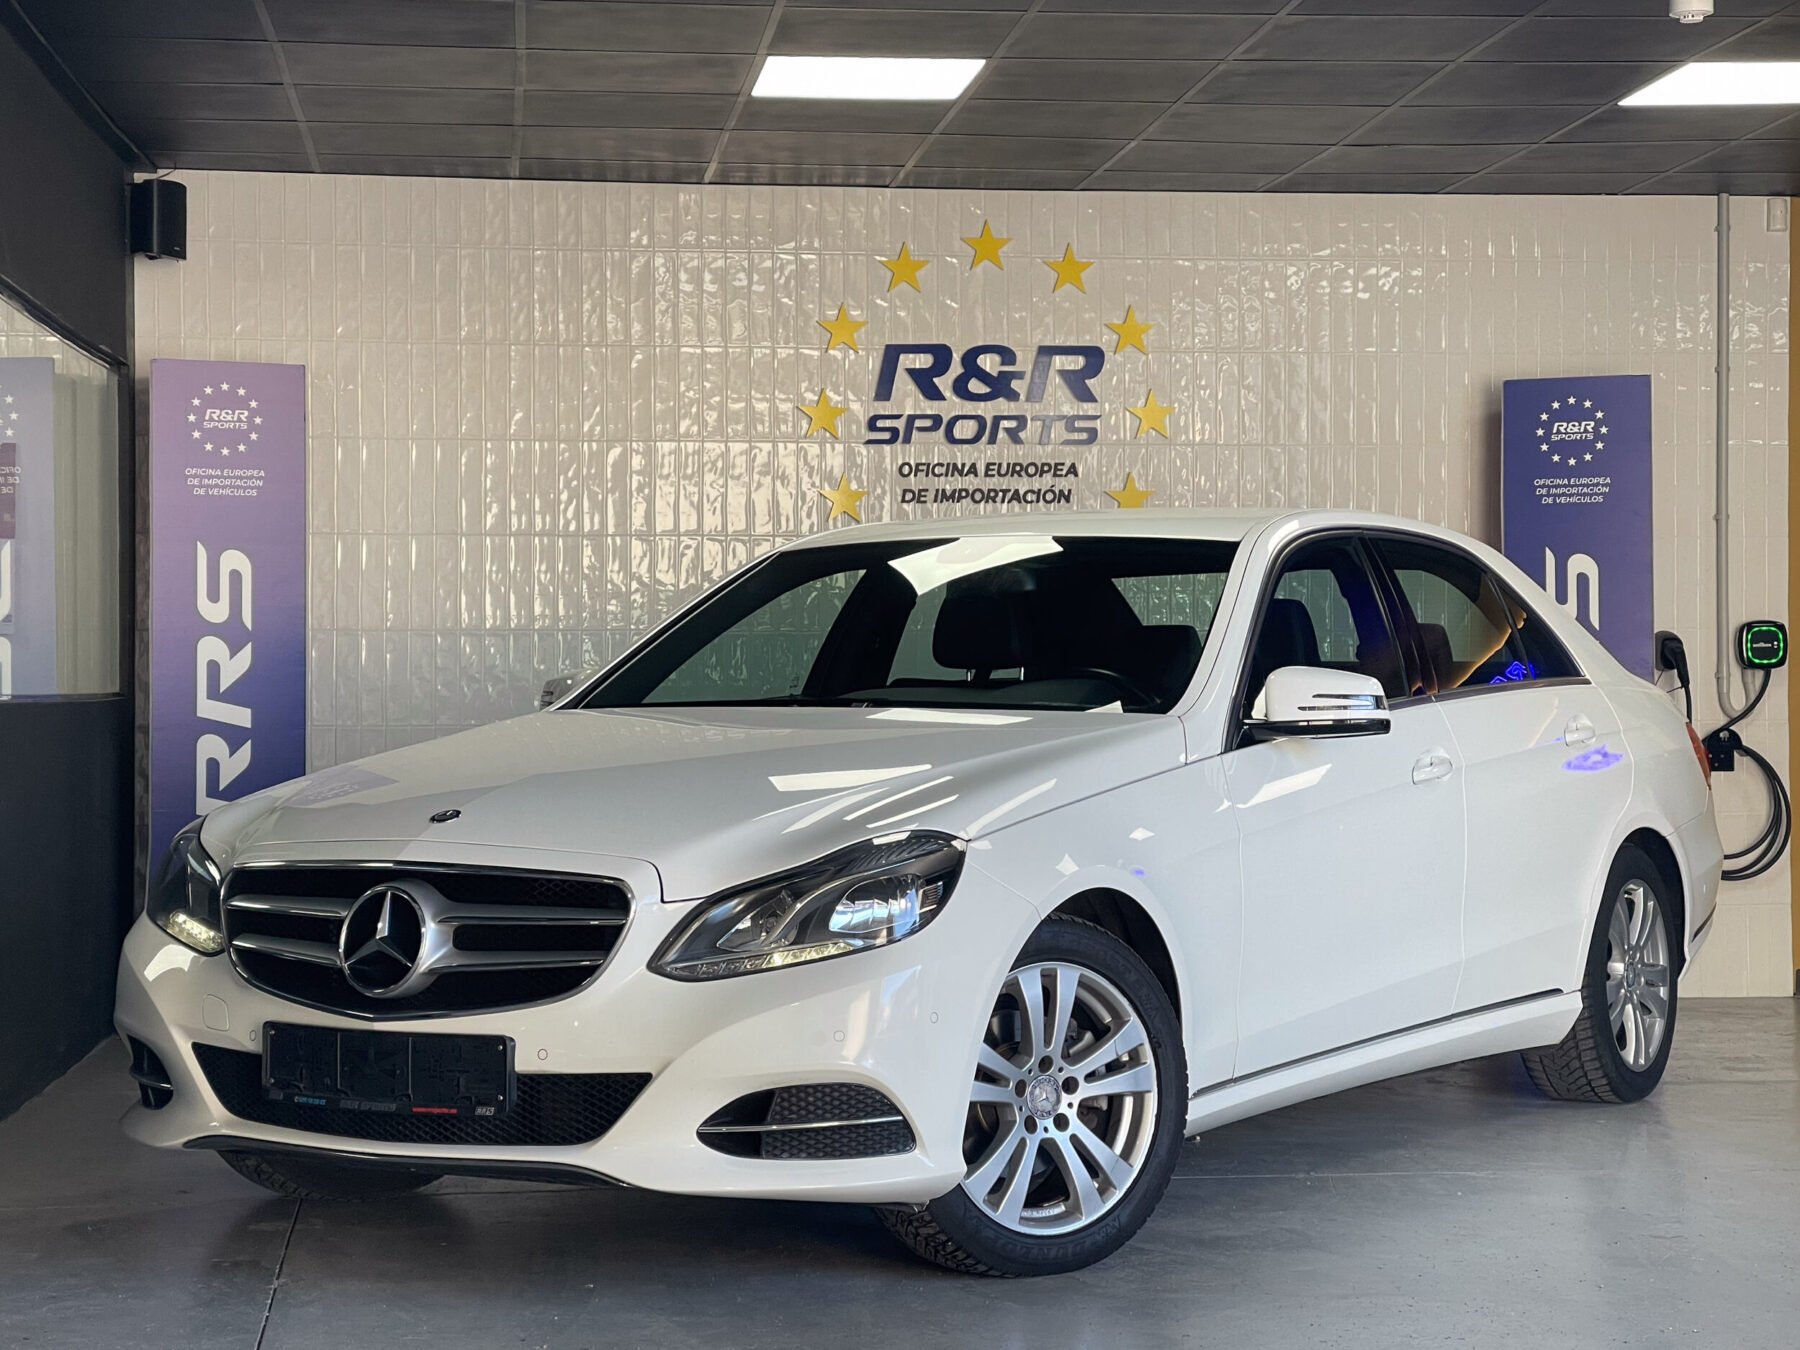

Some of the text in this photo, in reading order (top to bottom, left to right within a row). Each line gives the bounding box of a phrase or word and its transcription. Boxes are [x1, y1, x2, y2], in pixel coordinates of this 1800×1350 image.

[873, 343, 1105, 402] R&R
[204, 408, 249, 421] R&R
[203, 421, 248, 429] SPORTS
[863, 413, 1102, 445] SPORTS
[1552, 421, 1595, 433] R&R
[1550, 433, 1594, 441] SPORTS
[185, 467, 265, 477] OFICINA EUROPEA
[898, 462, 1079, 477] OFICINA EUROPEA
[187, 477, 264, 487] DE IMPORTACIÓN
[1534, 477, 1611, 486] OFICINA EUROPEA
[193, 486, 258, 497] DE VEHÍCULOS
[901, 485, 1072, 504] DE IMPORTACIÓN
[1536, 485, 1610, 495] DE IMPORTACIÓN
[1541, 495, 1604, 504] DE VEHÍCULOS
[196, 540, 251, 816] RRS
